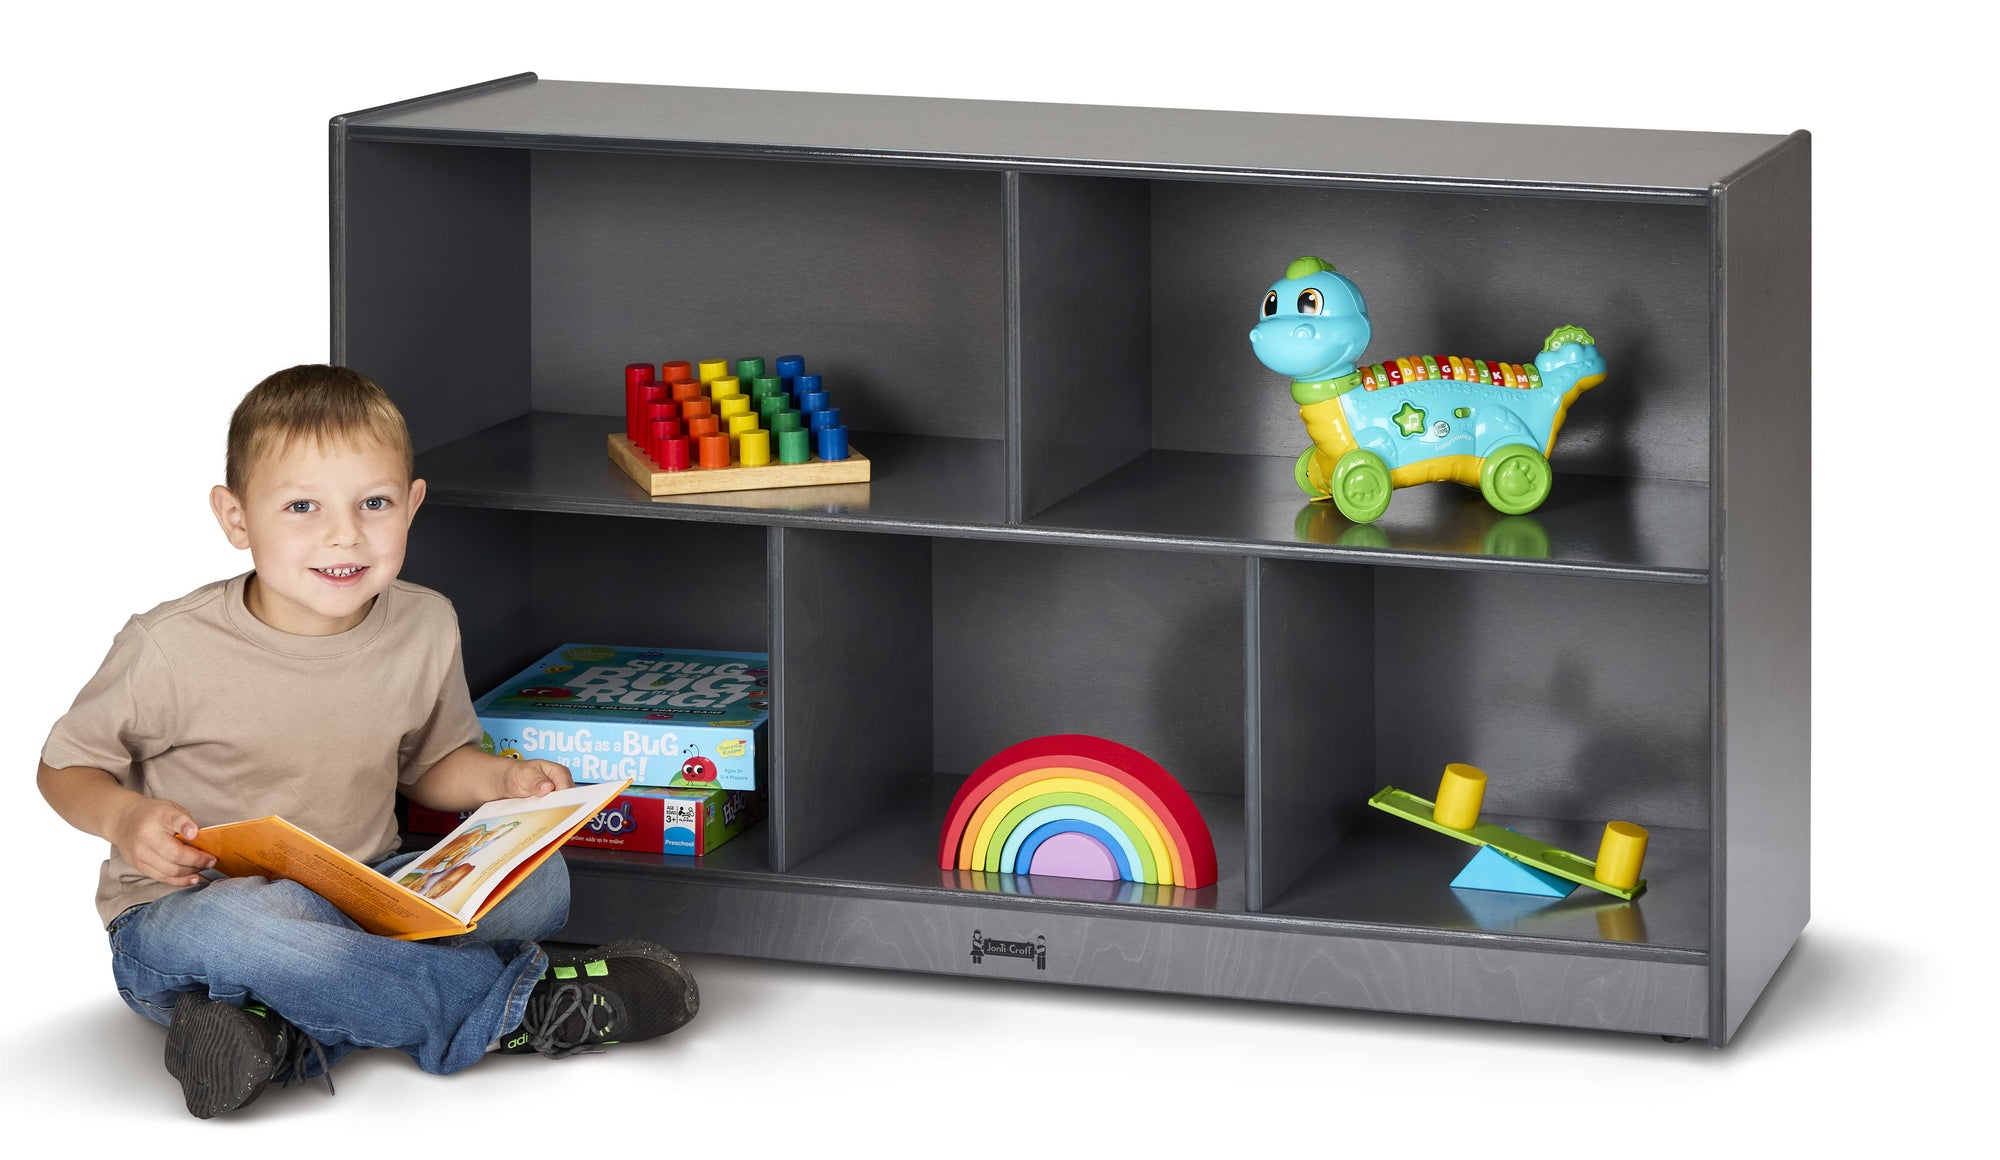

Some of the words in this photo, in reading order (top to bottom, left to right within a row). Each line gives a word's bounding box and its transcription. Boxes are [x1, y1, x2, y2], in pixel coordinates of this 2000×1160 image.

[1378, 374, 1387, 382] B
[1403, 368, 1412, 376] D
[1417, 366, 1425, 374] E
[1442, 365, 1451, 373] G
[1454, 366, 1463, 374] H
[1469, 368, 1476, 376] I
[1481, 369, 1488, 377] J
[1492, 372, 1502, 380] K
[594, 739, 610, 752] as
[613, 741, 621, 752] a
[557, 755, 570, 767] in
[572, 755, 581, 768] a
[666, 815, 676, 823] 3+
[664, 839, 695, 847] Preschool
[508, 1032, 529, 1049] adi
